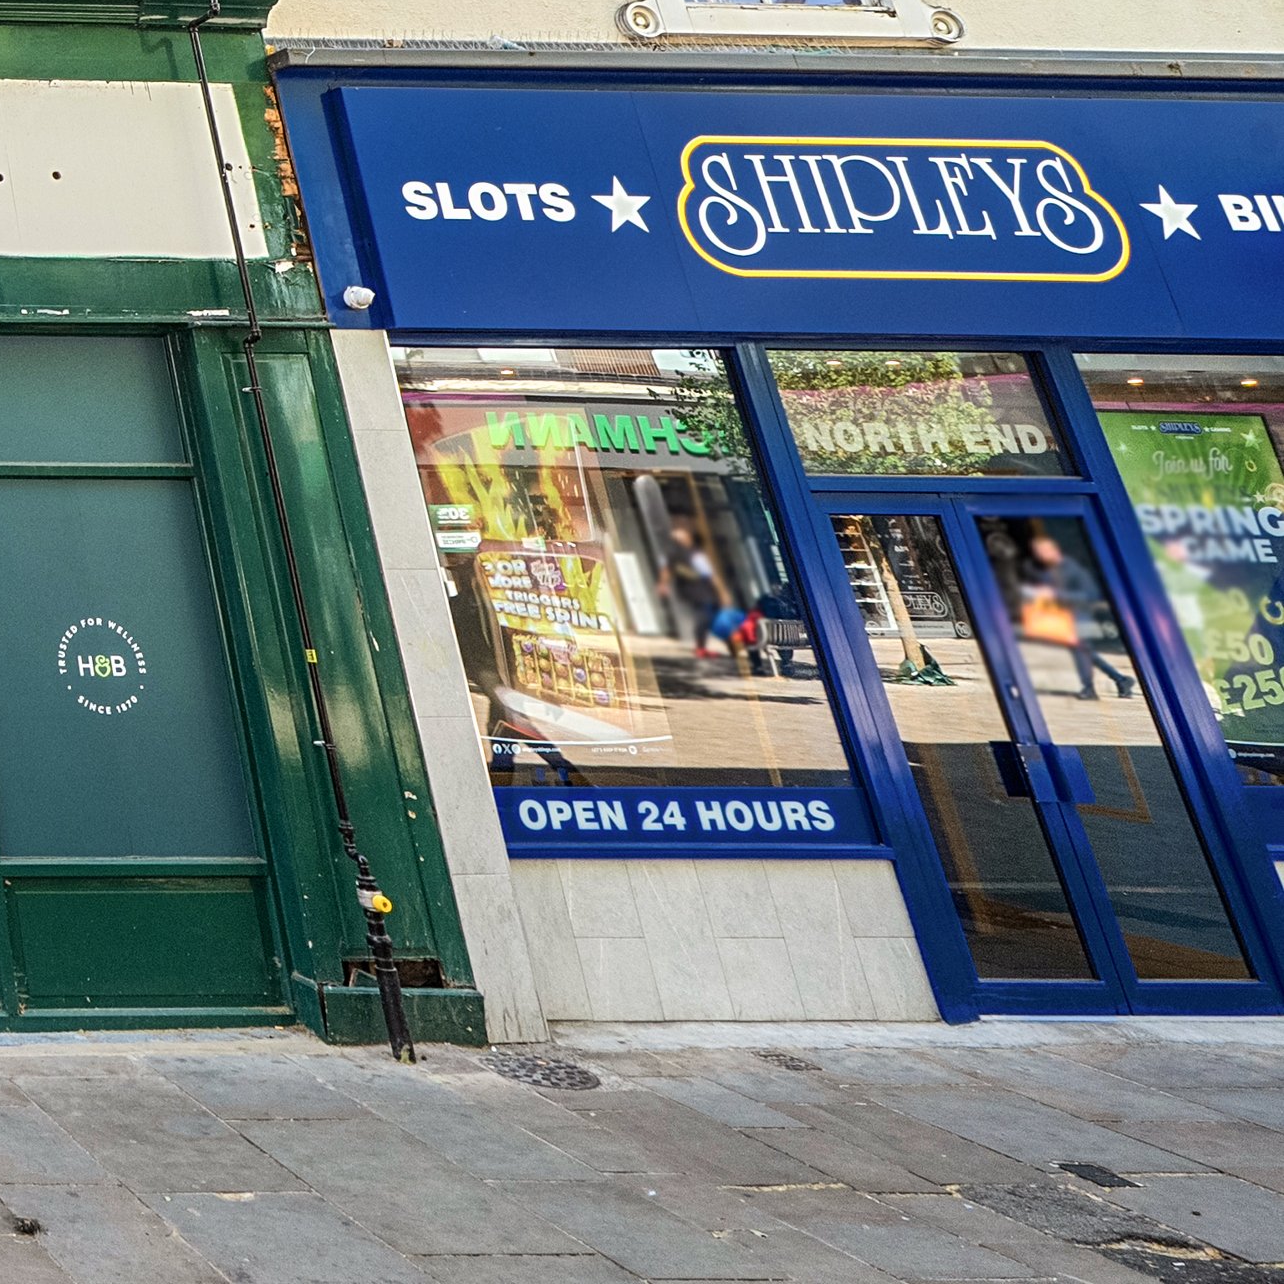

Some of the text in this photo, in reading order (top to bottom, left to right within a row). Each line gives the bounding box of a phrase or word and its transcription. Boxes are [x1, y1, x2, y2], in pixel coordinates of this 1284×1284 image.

[400, 180, 577, 223] SLOTS
[697, 151, 1105, 257] SHIPLEYS
[801, 419, 1048, 455] NORTH END
[1152, 447, 1233, 481] Join us for
[1133, 503, 1284, 538] SPRING
[1182, 536, 1279, 564] GAME
[496, 559, 528, 576] OR
[492, 600, 542, 620] FREE
[504, 589, 581, 610] TRIGGERS
[57, 617, 147, 675] TRUSTED FOR WELLNESS
[1203, 626, 1275, 666] £50
[77, 654, 127, 678] H&B
[77, 695, 138, 715] SINCE 1870
[1215, 667, 1284, 715] £25
[518, 798, 836, 832] OPEN 24 HOURS
